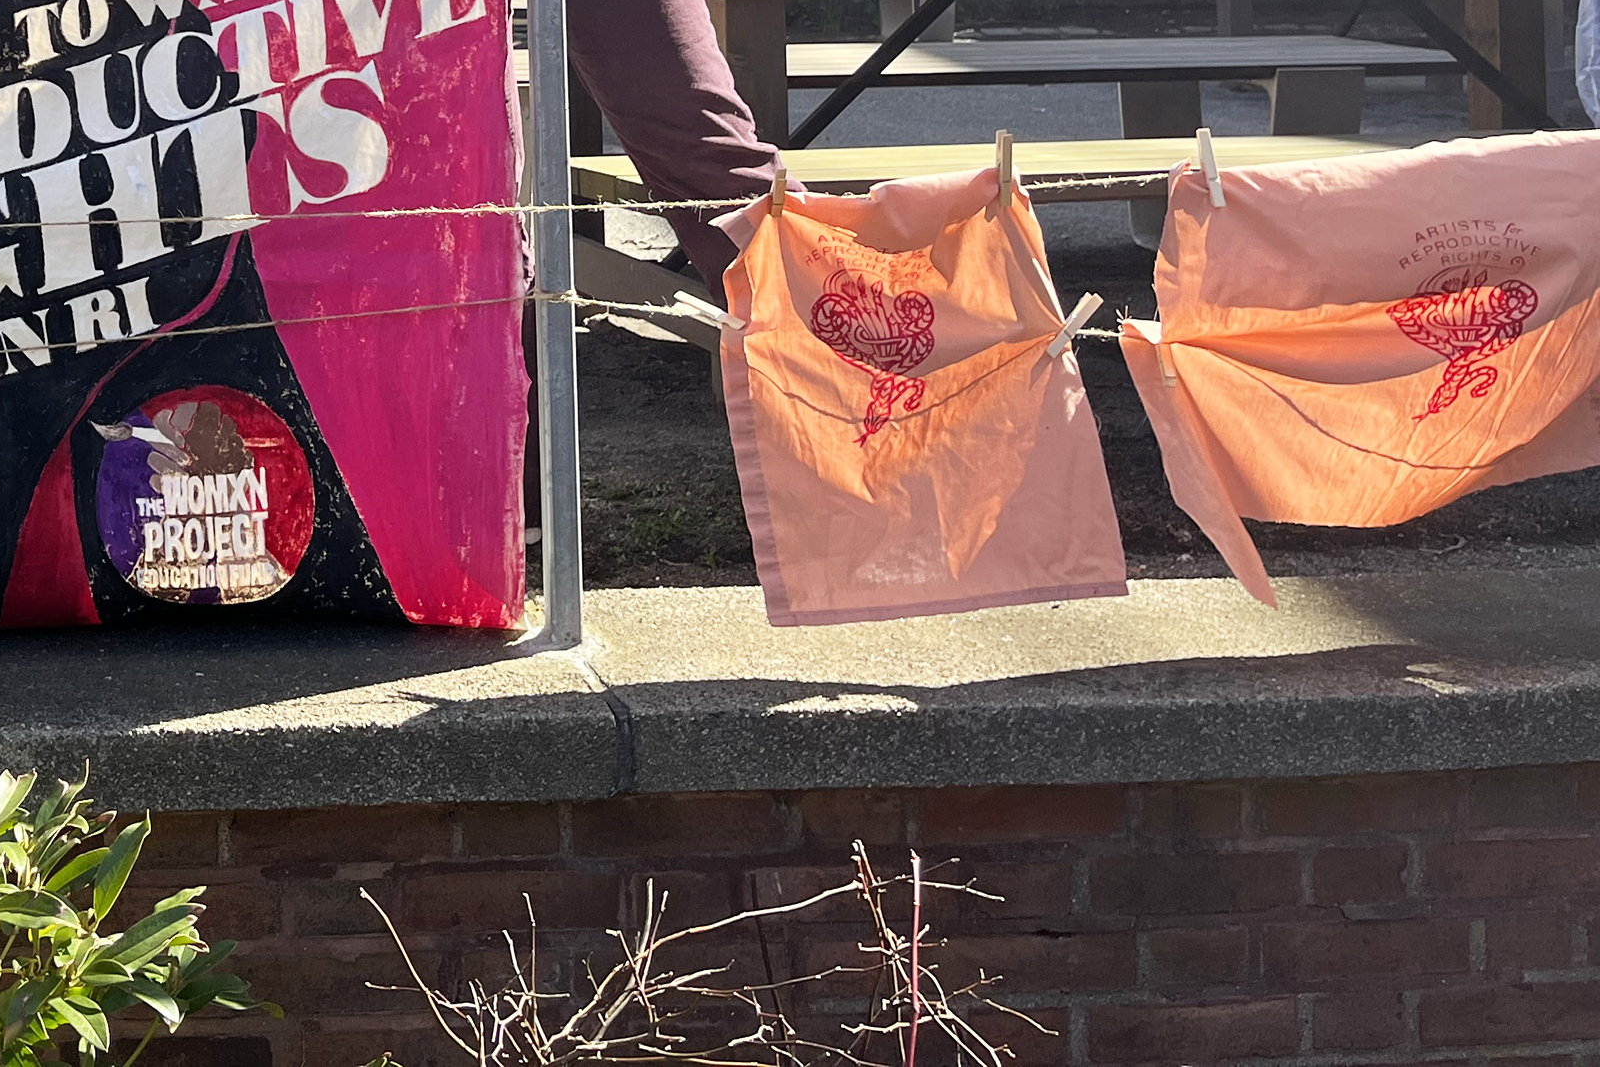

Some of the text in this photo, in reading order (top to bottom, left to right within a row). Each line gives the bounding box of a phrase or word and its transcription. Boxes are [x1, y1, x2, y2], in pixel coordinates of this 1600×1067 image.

[1399, 235, 1541, 270] REPRODUCTIVE
[1415, 220, 1523, 242] ARTISTS for
[1441, 250, 1501, 267] RIGHTS
[64, 277, 162, 354] RI
[135, 466, 268, 517] THE WOMXN
[143, 511, 268, 563] PROJECT
